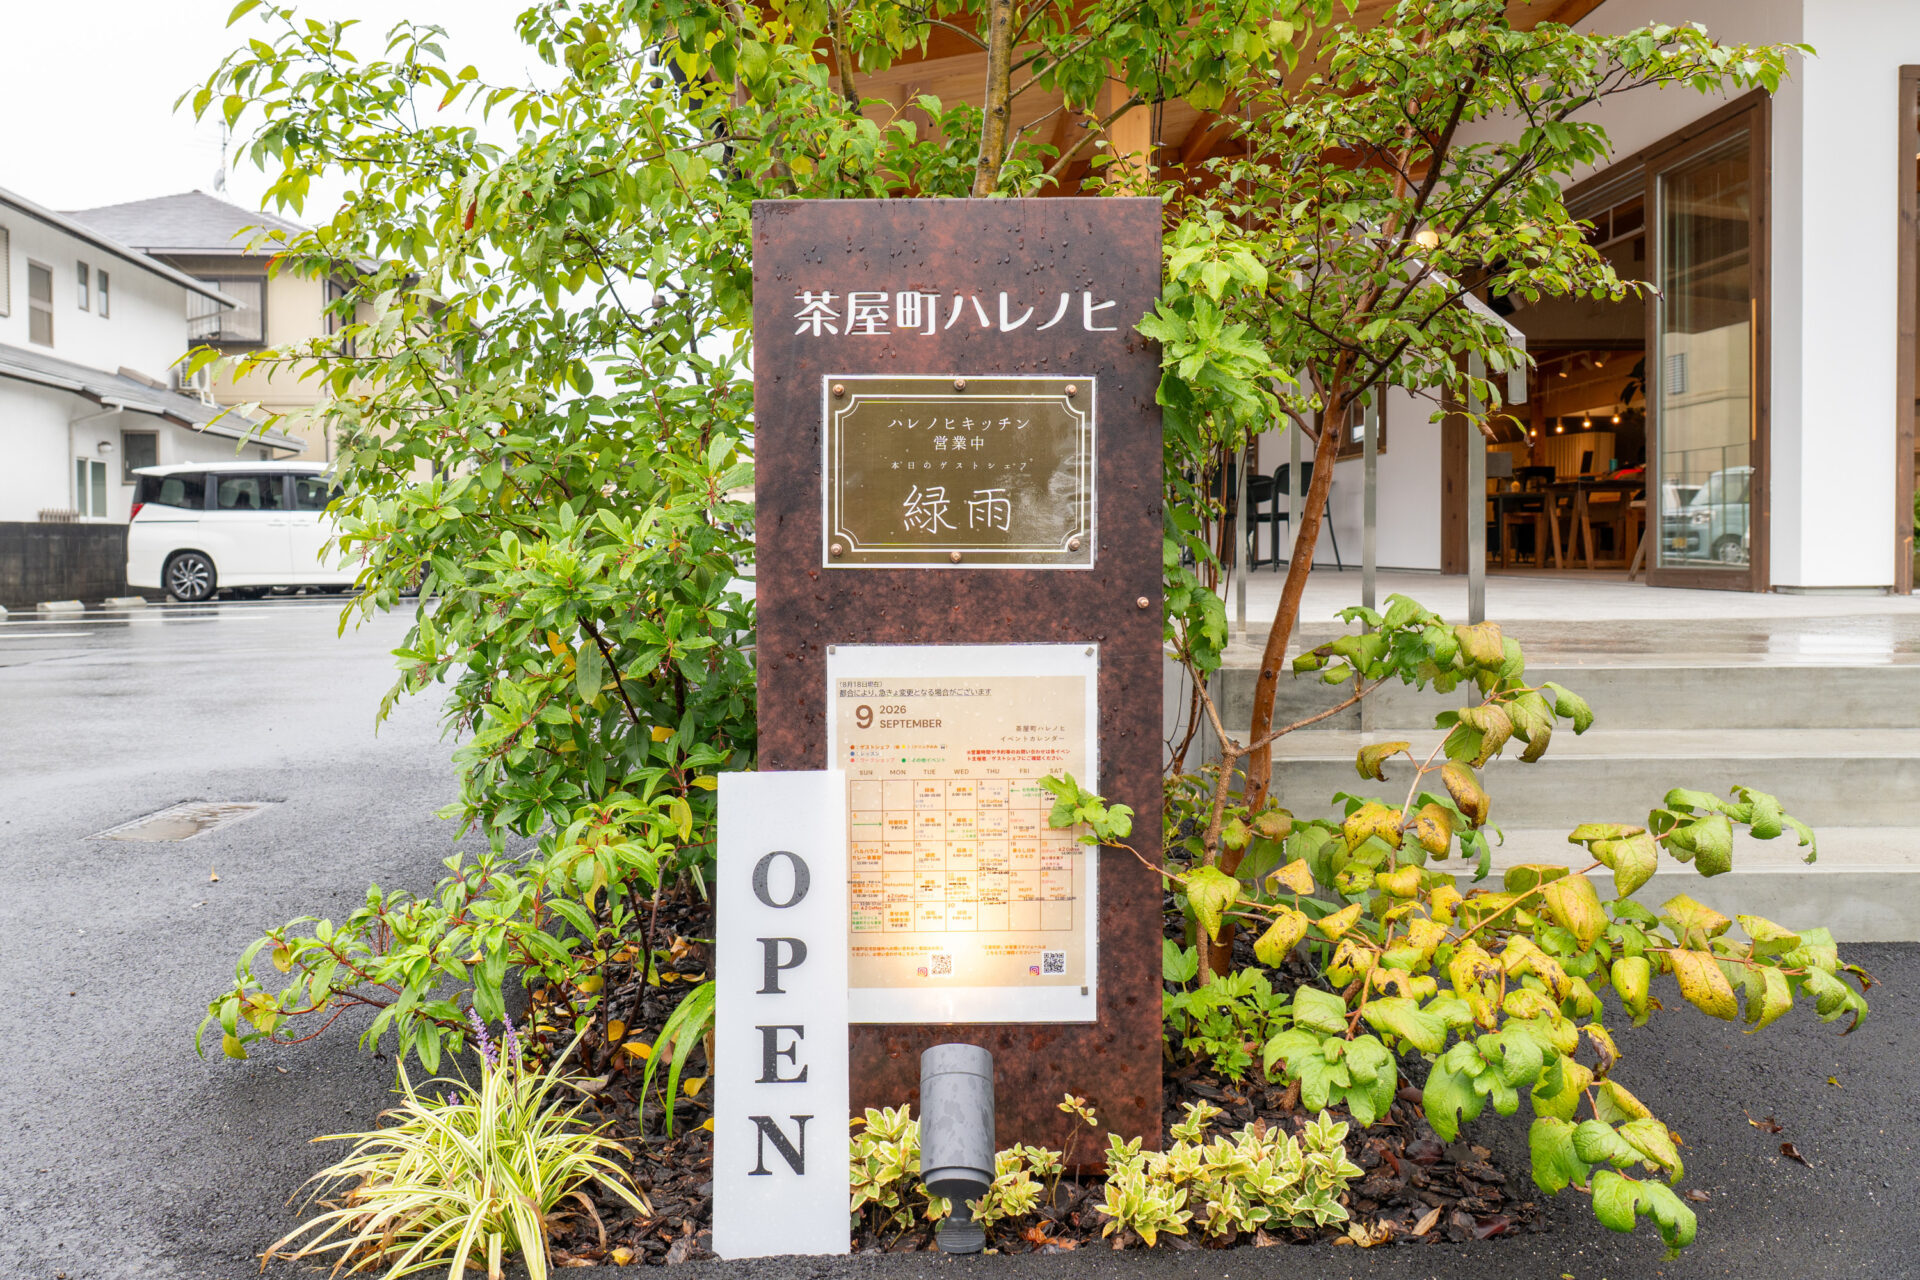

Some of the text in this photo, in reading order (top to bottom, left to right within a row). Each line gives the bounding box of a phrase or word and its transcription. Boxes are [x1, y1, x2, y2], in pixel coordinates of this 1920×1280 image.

[794, 290, 1118, 337] 茶屋町ハレノヒ
[887, 416, 1030, 432] ハレノヒキッチン
[933, 435, 985, 452] 営業中
[891, 460, 1028, 471] 本日のゲストシェフ
[903, 484, 1012, 535] 緑雨
[855, 704, 874, 729] 9
[879, 705, 907, 714] 2026
[879, 719, 942, 728] SEPTEMBER
[748, 850, 814, 1177] OPEN
